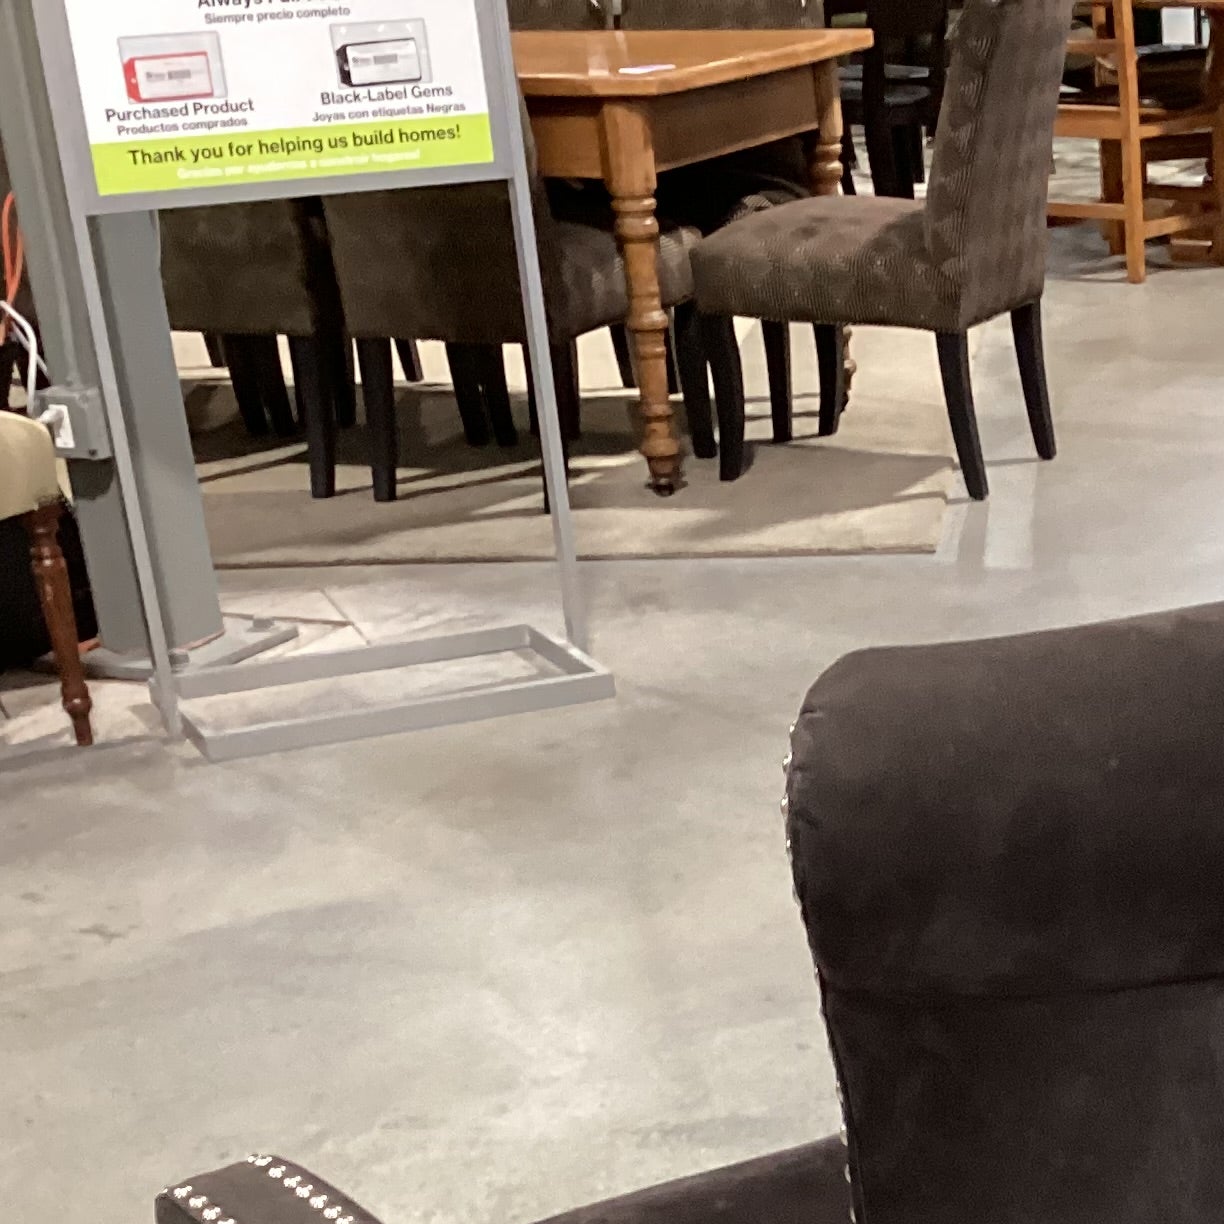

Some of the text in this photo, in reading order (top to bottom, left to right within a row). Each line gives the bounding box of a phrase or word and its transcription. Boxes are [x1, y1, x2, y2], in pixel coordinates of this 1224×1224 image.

[204, 6, 351, 24] Siempre precio completo
[320, 85, 453, 105] Black-Label Gems
[105, 98, 255, 122] Purchased Product
[312, 111, 346, 123] Joyas
[348, 110, 369, 119] con
[372, 104, 424, 118] etiquetas
[117, 117, 248, 137] Productos comprados
[128, 124, 461, 167] Thank you for helping us build homes!
